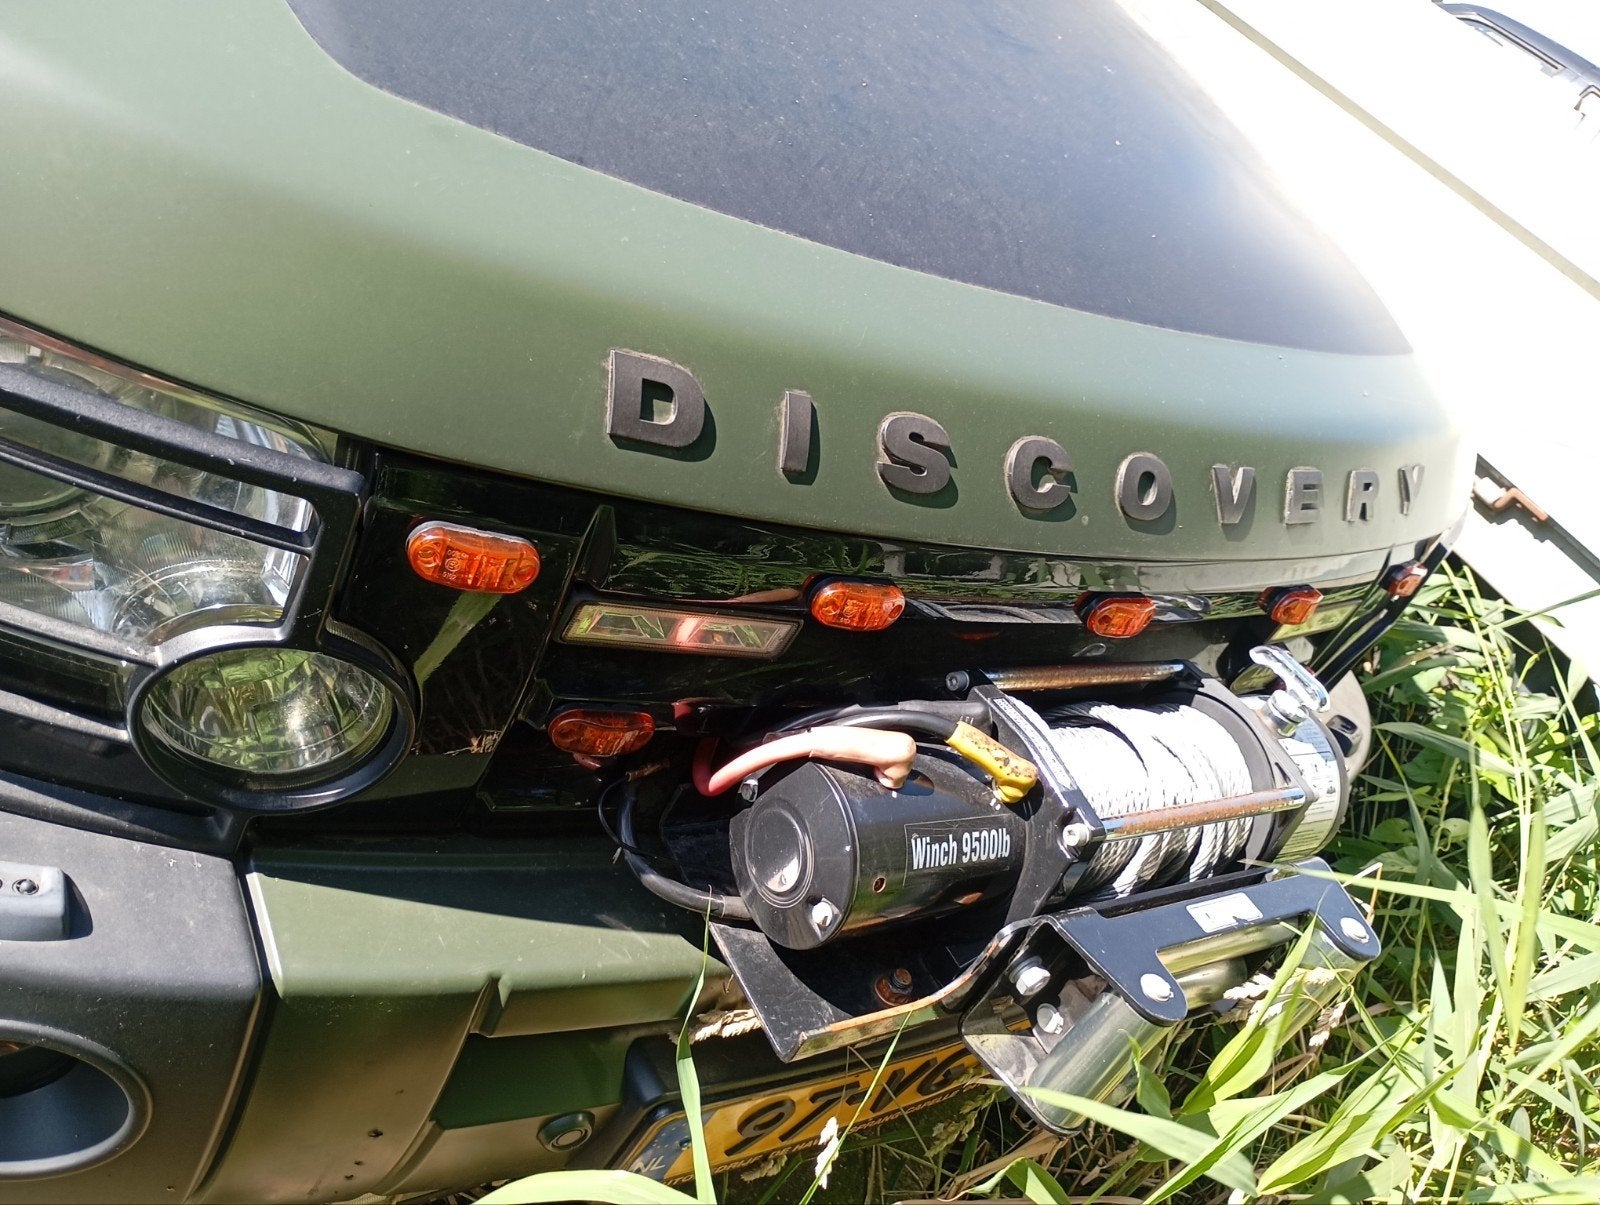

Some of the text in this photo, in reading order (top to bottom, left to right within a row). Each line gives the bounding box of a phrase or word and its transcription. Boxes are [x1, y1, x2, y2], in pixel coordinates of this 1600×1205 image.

[605, 348, 1426, 525] DISCOVERY
[911, 828, 1011, 869] Winch 9500lb
[629, 1155, 666, 1174] NL
